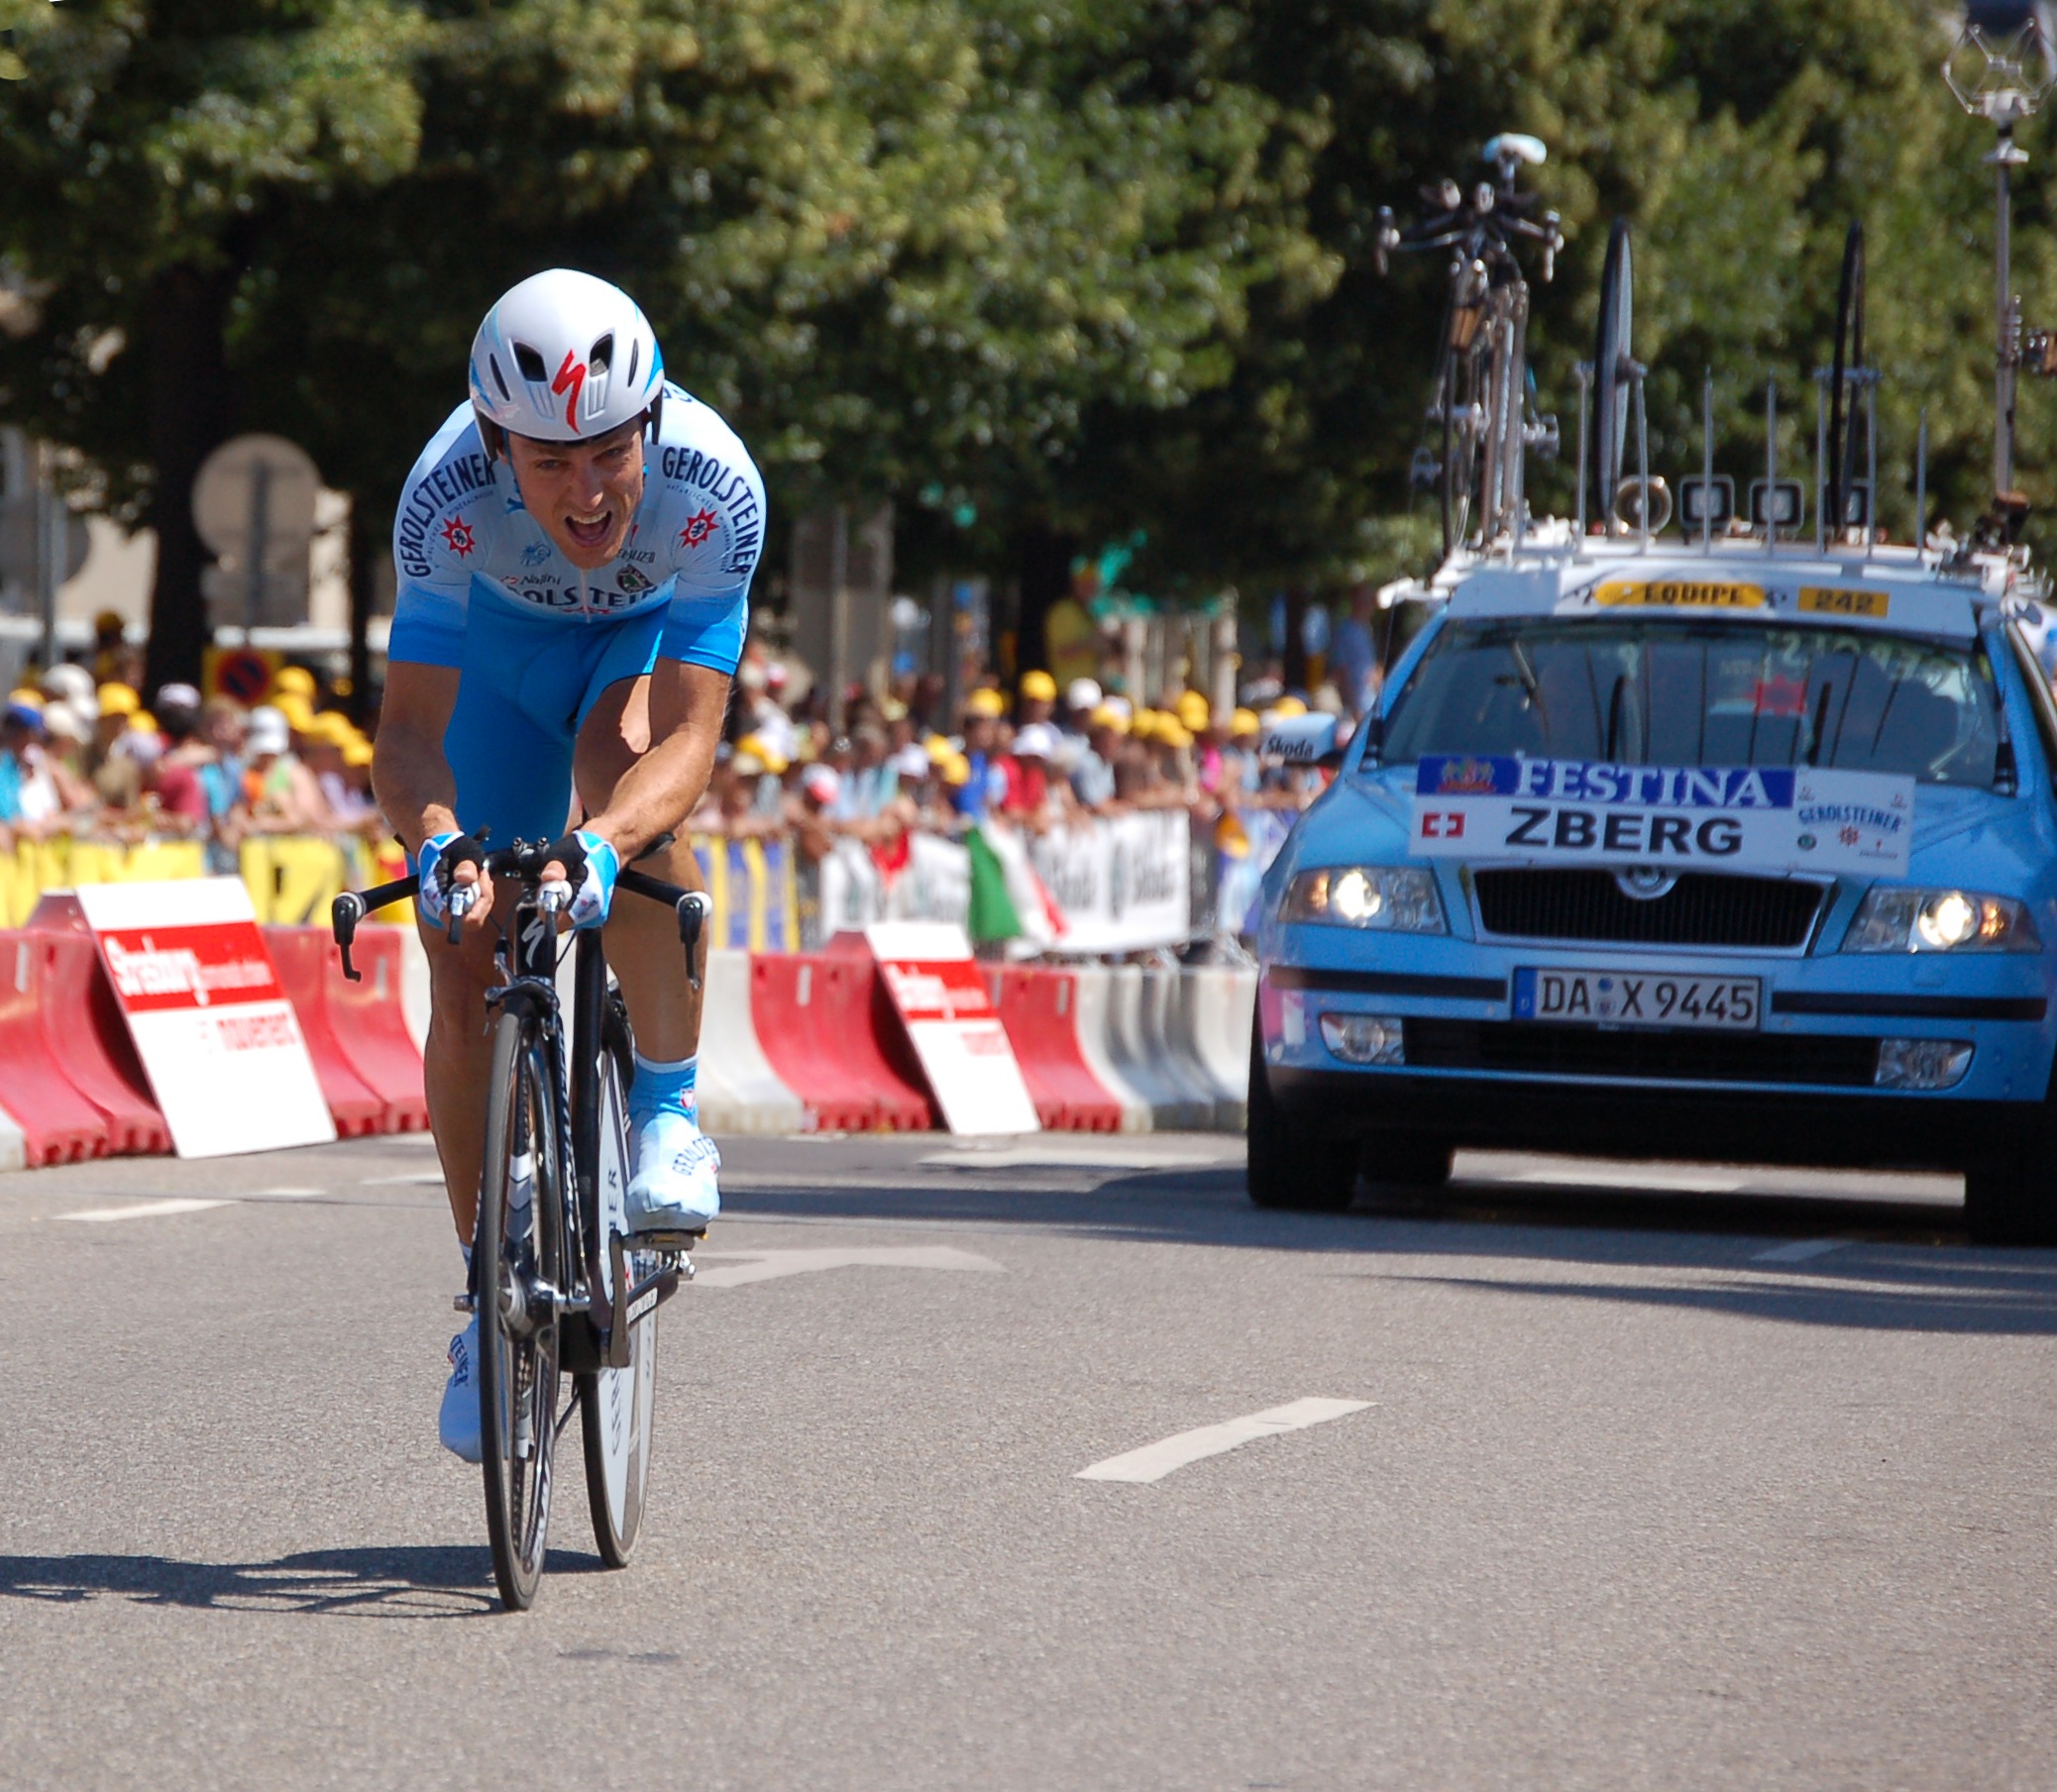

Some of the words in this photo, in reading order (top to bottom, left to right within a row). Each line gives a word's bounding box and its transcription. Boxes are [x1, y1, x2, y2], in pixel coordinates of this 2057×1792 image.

[662, 446, 759, 575] GEROLSTEINER
[520, 573, 562, 585] Nalini
[1644, 580, 1744, 606] EQUIPE
[1514, 758, 1774, 808] FESTINA
[1504, 805, 1744, 857] ZBERG
[1541, 976, 1591, 1014] DA
[1620, 979, 1645, 1017] X
[1655, 981, 1755, 1021] 9445
